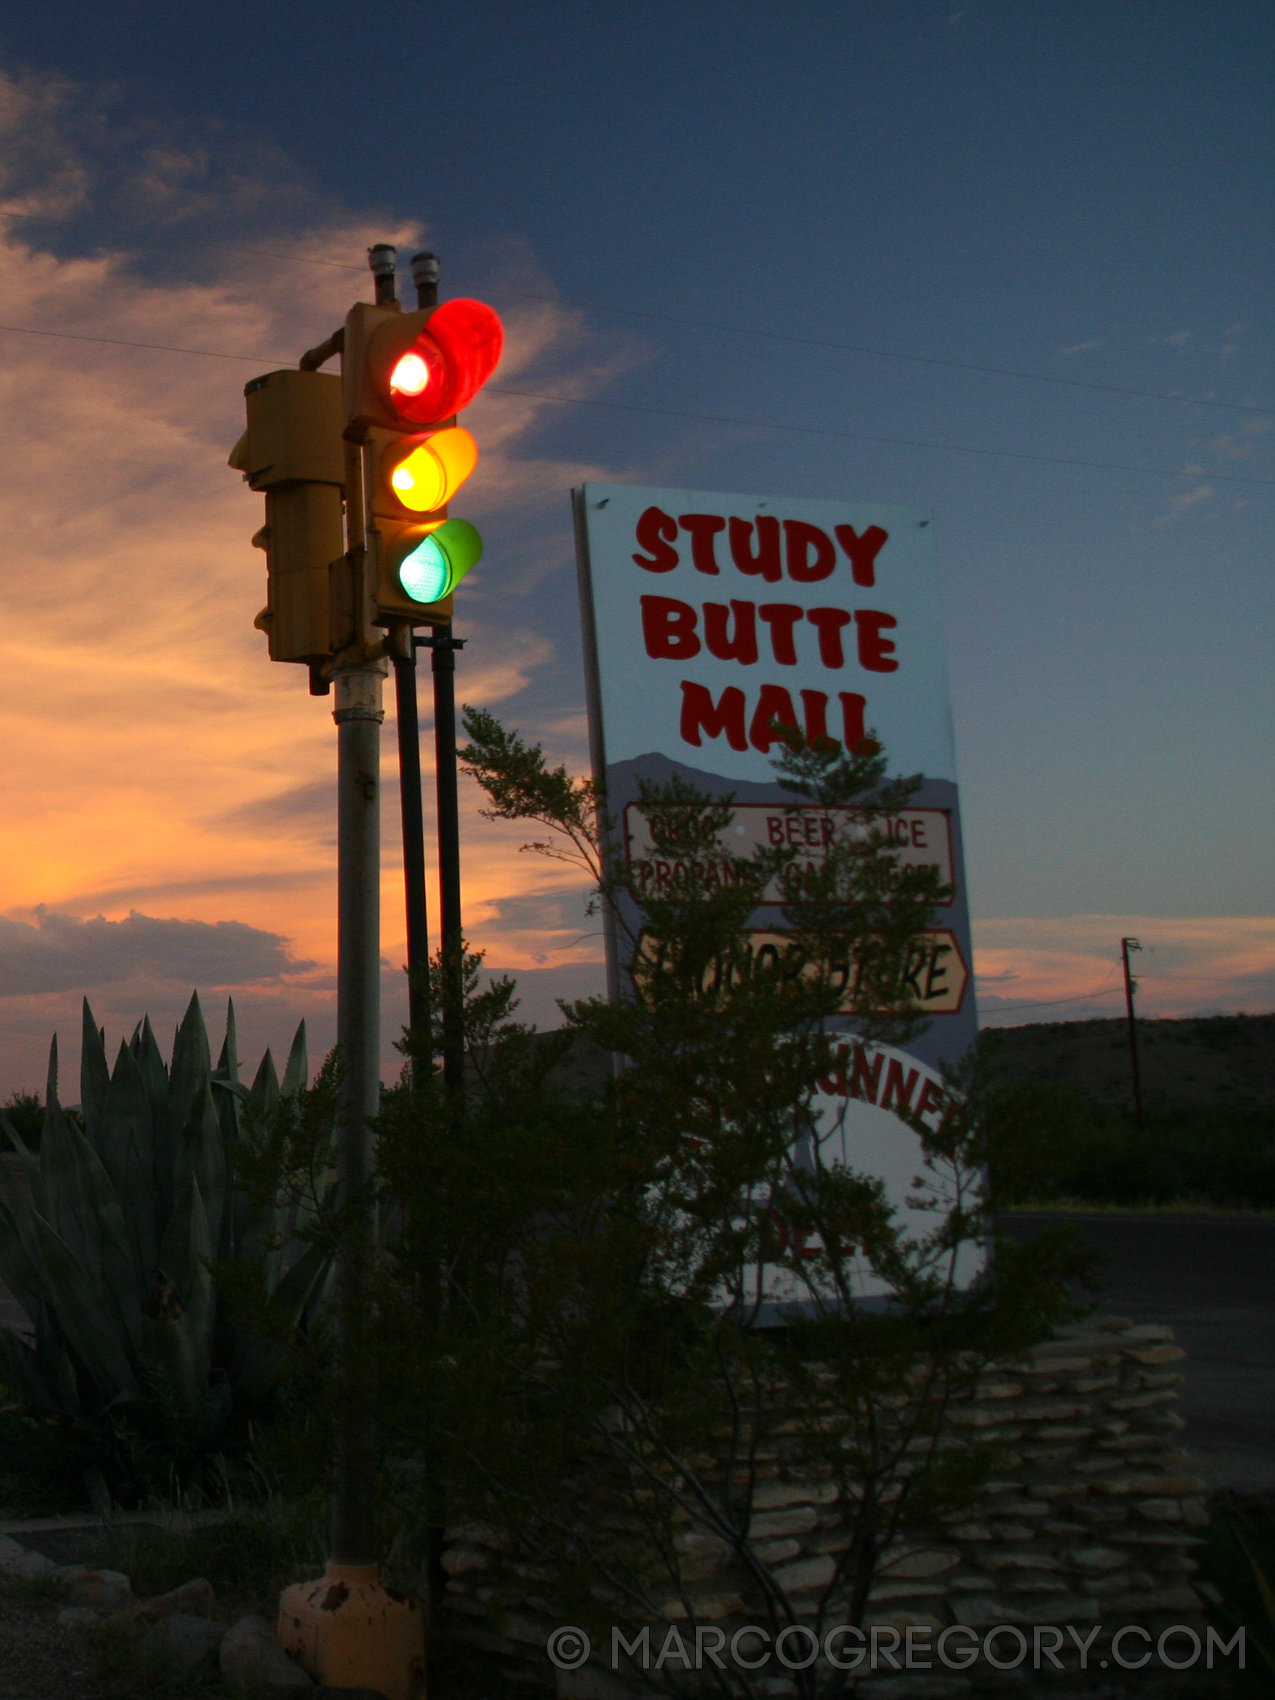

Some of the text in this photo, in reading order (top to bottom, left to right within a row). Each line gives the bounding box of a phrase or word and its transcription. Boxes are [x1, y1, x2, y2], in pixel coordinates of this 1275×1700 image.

[631, 505, 889, 588] STUDY
[639, 594, 900, 674] BUTTE
[679, 679, 882, 757] MALL
[766, 816, 837, 847] BEER
[885, 818, 929, 849] ICE
